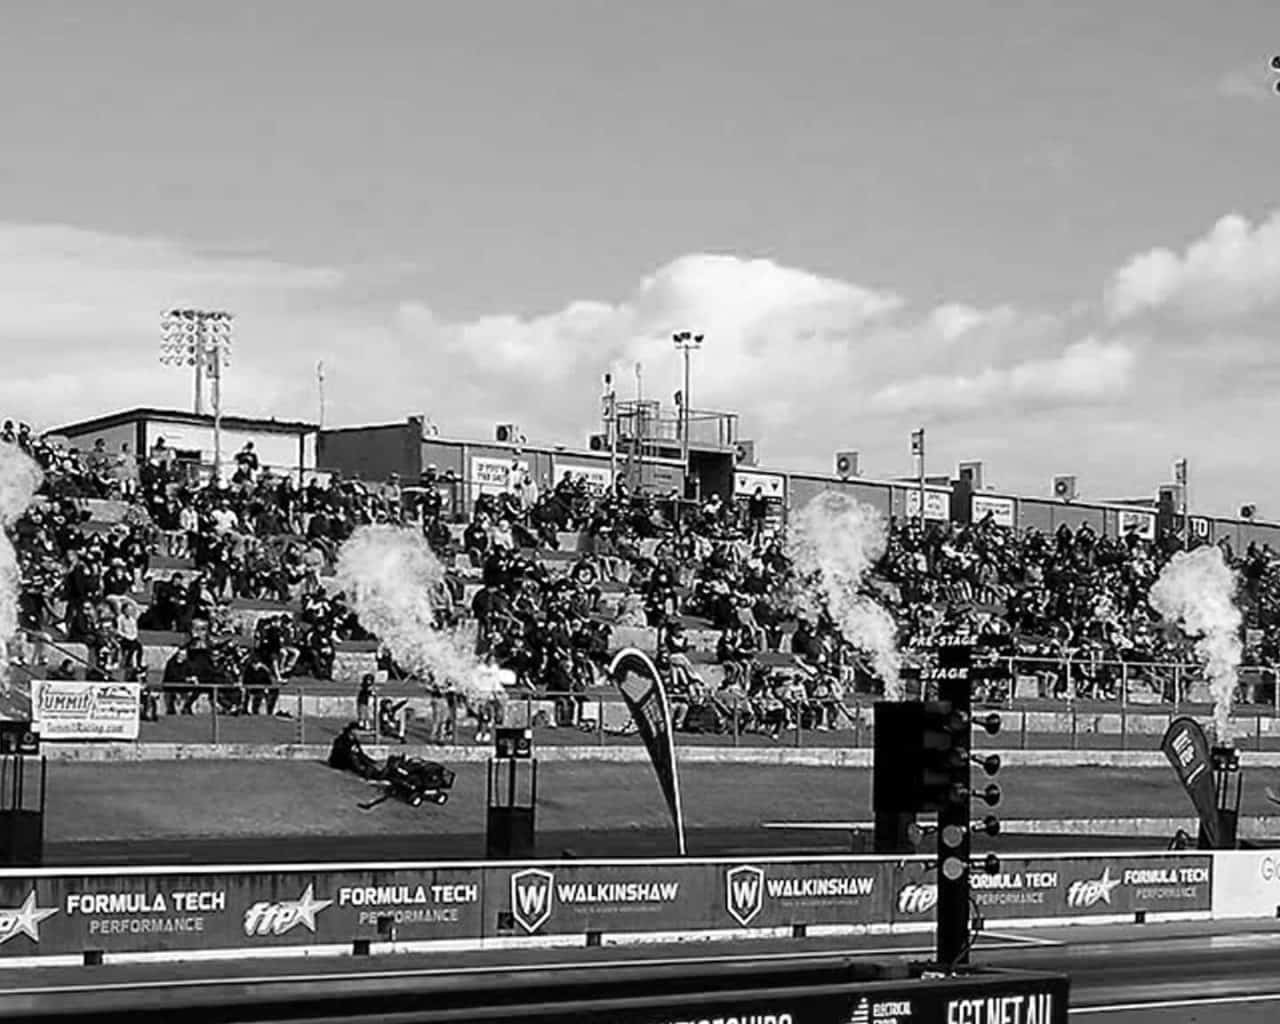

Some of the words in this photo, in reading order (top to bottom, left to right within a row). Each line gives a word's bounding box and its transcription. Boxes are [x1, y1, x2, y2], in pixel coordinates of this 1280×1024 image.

[908, 634, 979, 648] PRE-STAGE
[919, 667, 969, 680] STAGE
[969, 873, 1023, 889] ORMULA
[1025, 871, 1058, 888] TECH
[1124, 869, 1178, 885] FORMULA
[1179, 867, 1209, 883] TECH
[339, 886, 426, 906] FORMULA
[431, 884, 478, 902] TECH
[557, 882, 679, 903] WALKINSHAW
[733, 880, 758, 909] W
[767, 877, 874, 897] WALKINSHAW
[67, 893, 165, 914] FORMULA
[172, 891, 225, 911] TECH
[518, 885, 547, 915] W
[89, 916, 204, 935] PERFORMANCE
